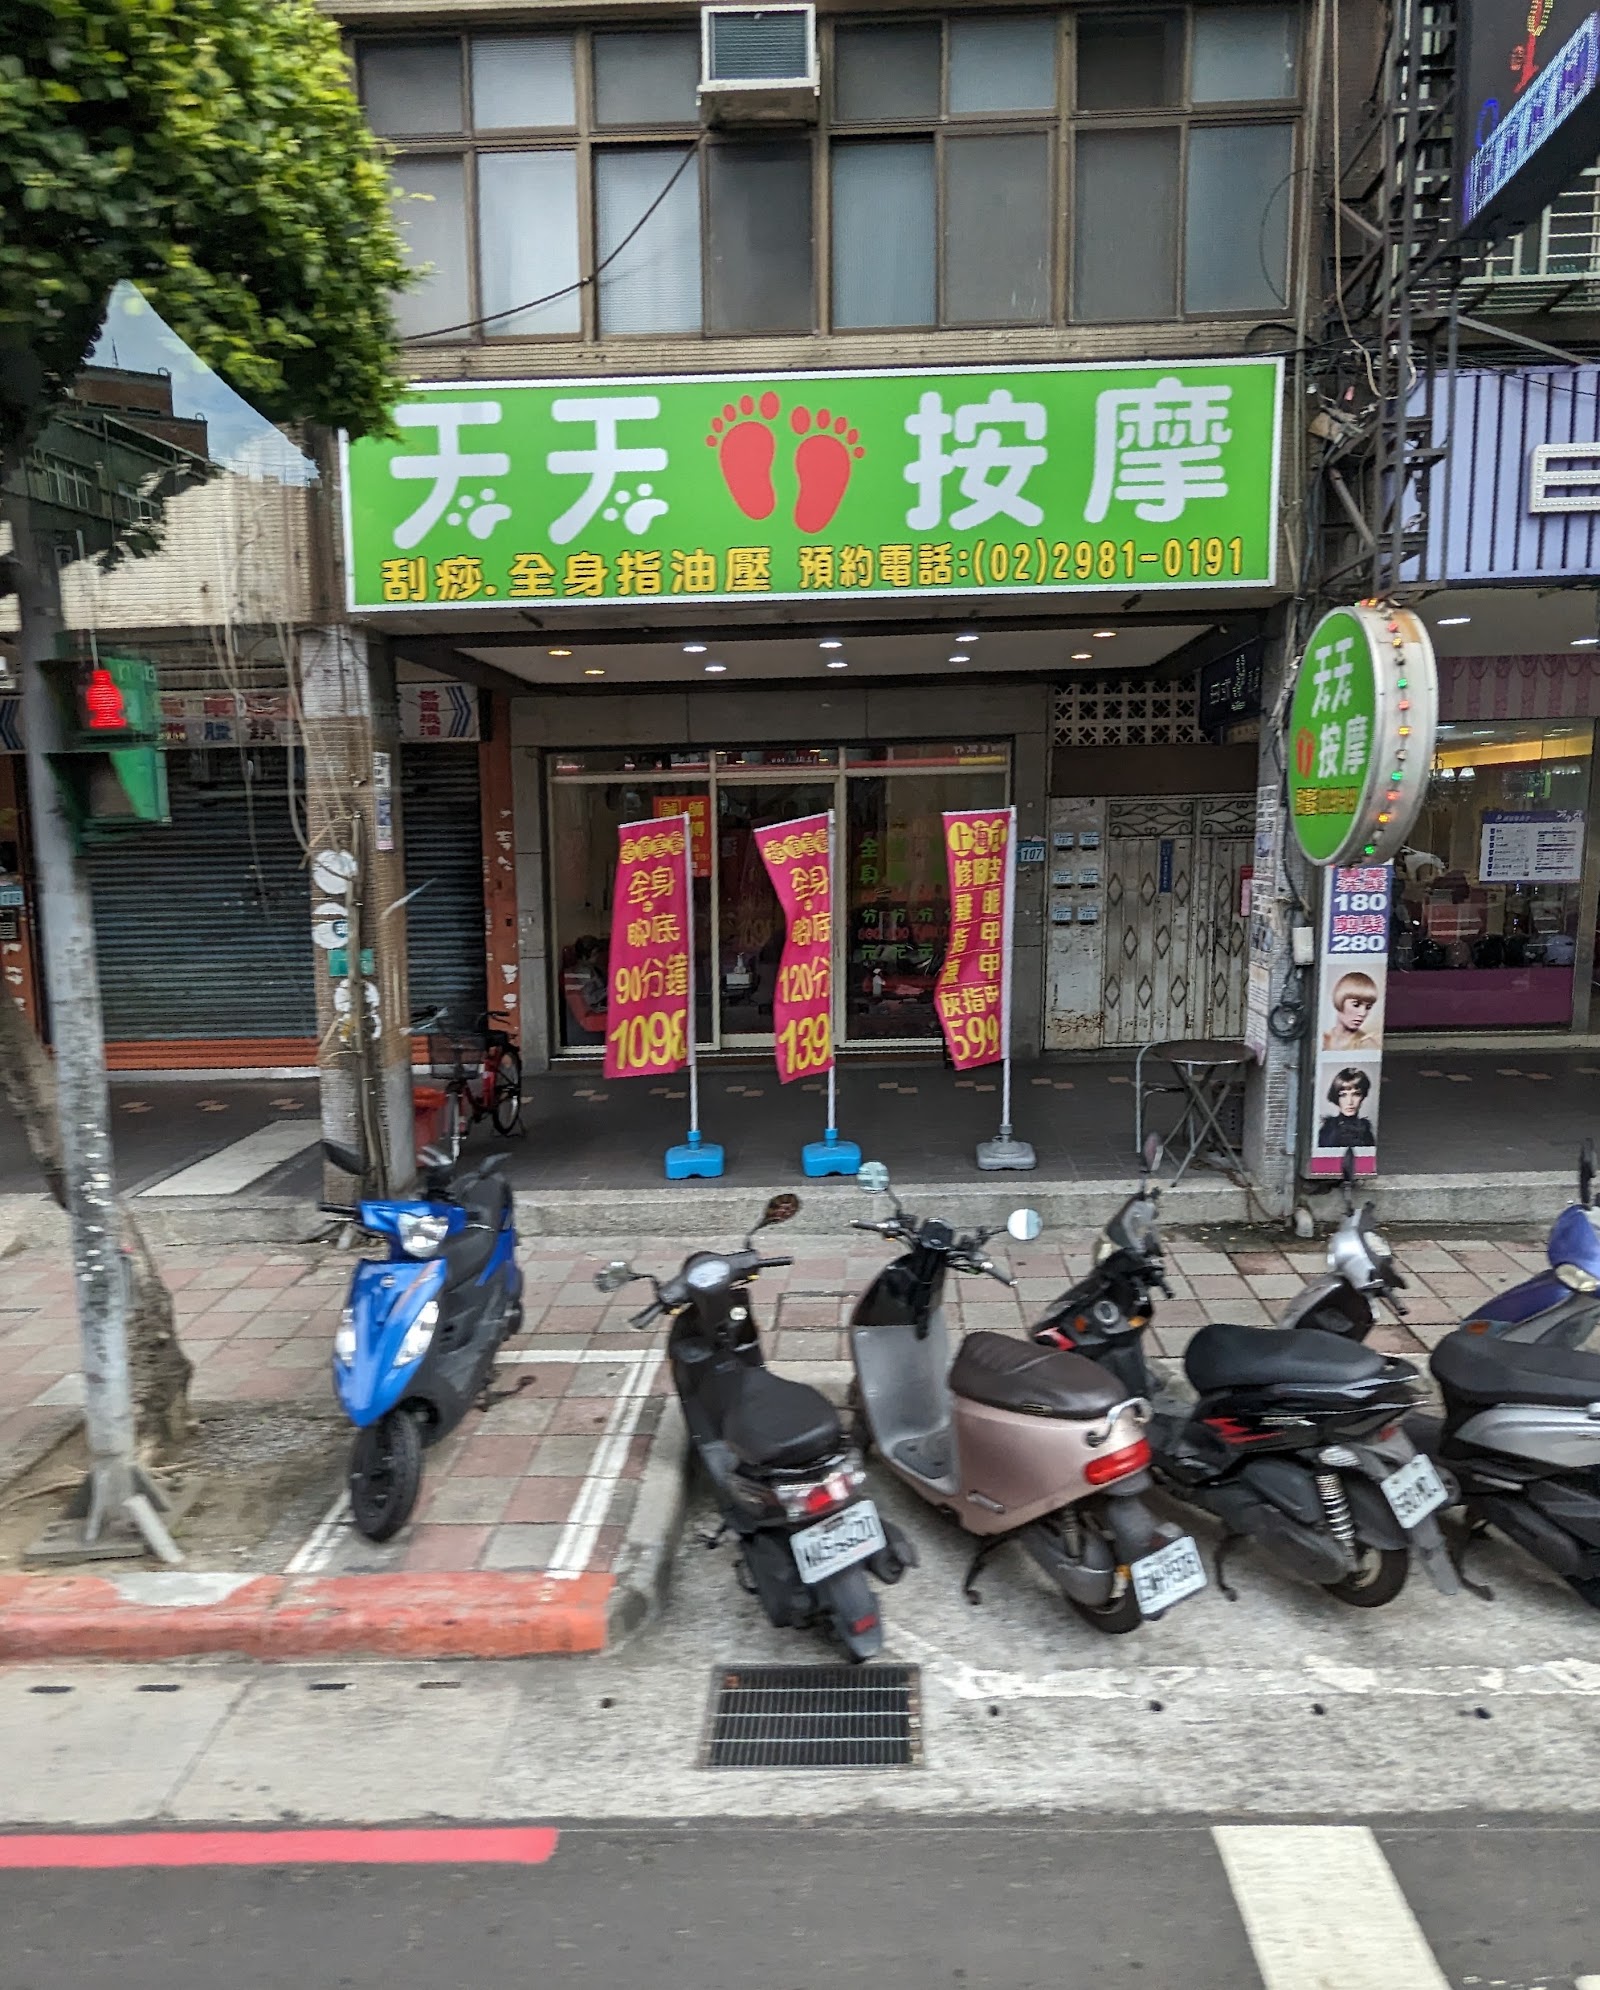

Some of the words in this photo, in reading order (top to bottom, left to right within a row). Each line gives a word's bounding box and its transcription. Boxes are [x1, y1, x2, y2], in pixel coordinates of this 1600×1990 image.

[389, 395, 669, 549] 天天
[904, 376, 1234, 532] 按摩
[1023, 848, 1043, 861] 107
[627, 865, 676, 905] 全身
[789, 865, 830, 901] 全身
[1333, 893, 1388, 912] 180
[1330, 935, 1386, 952] 280
[946, 1016, 999, 1061] 599
